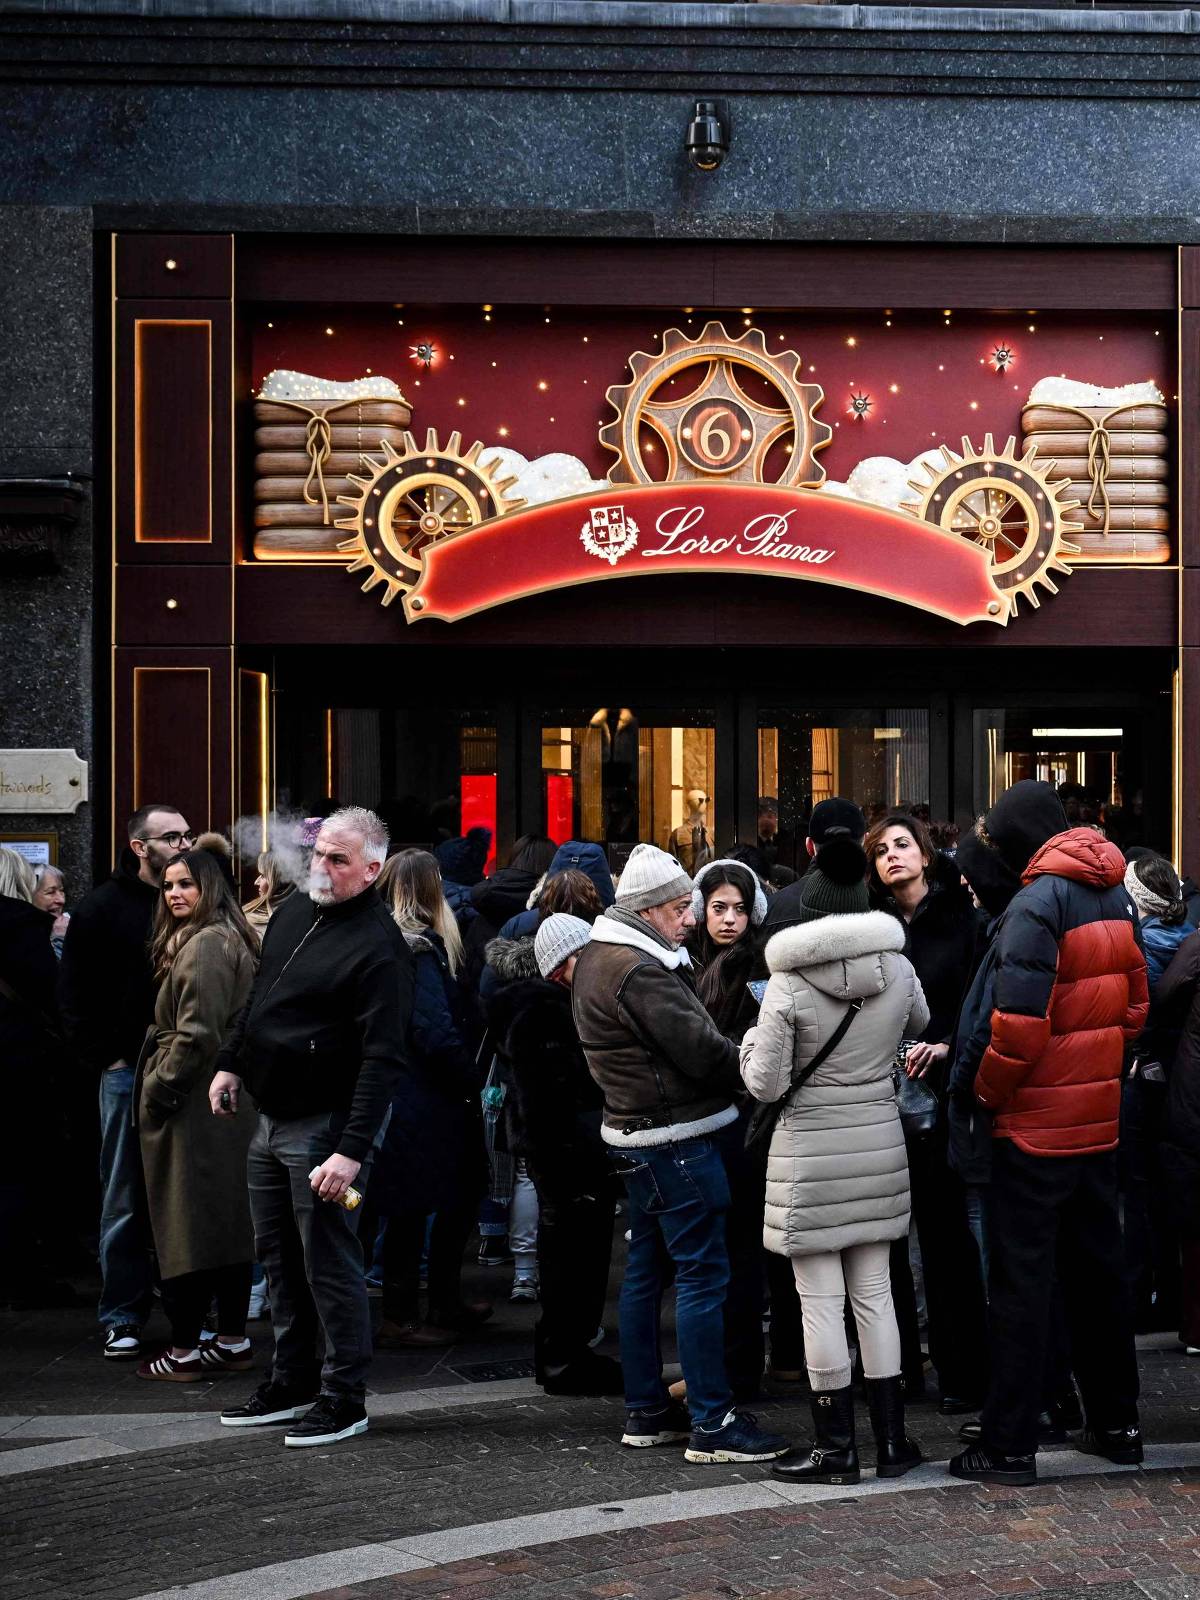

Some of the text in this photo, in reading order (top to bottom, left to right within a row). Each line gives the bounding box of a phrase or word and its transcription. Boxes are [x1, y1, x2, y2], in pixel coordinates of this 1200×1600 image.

[701, 411, 731, 460] 6
[642, 506, 836, 564] Loro Piana
